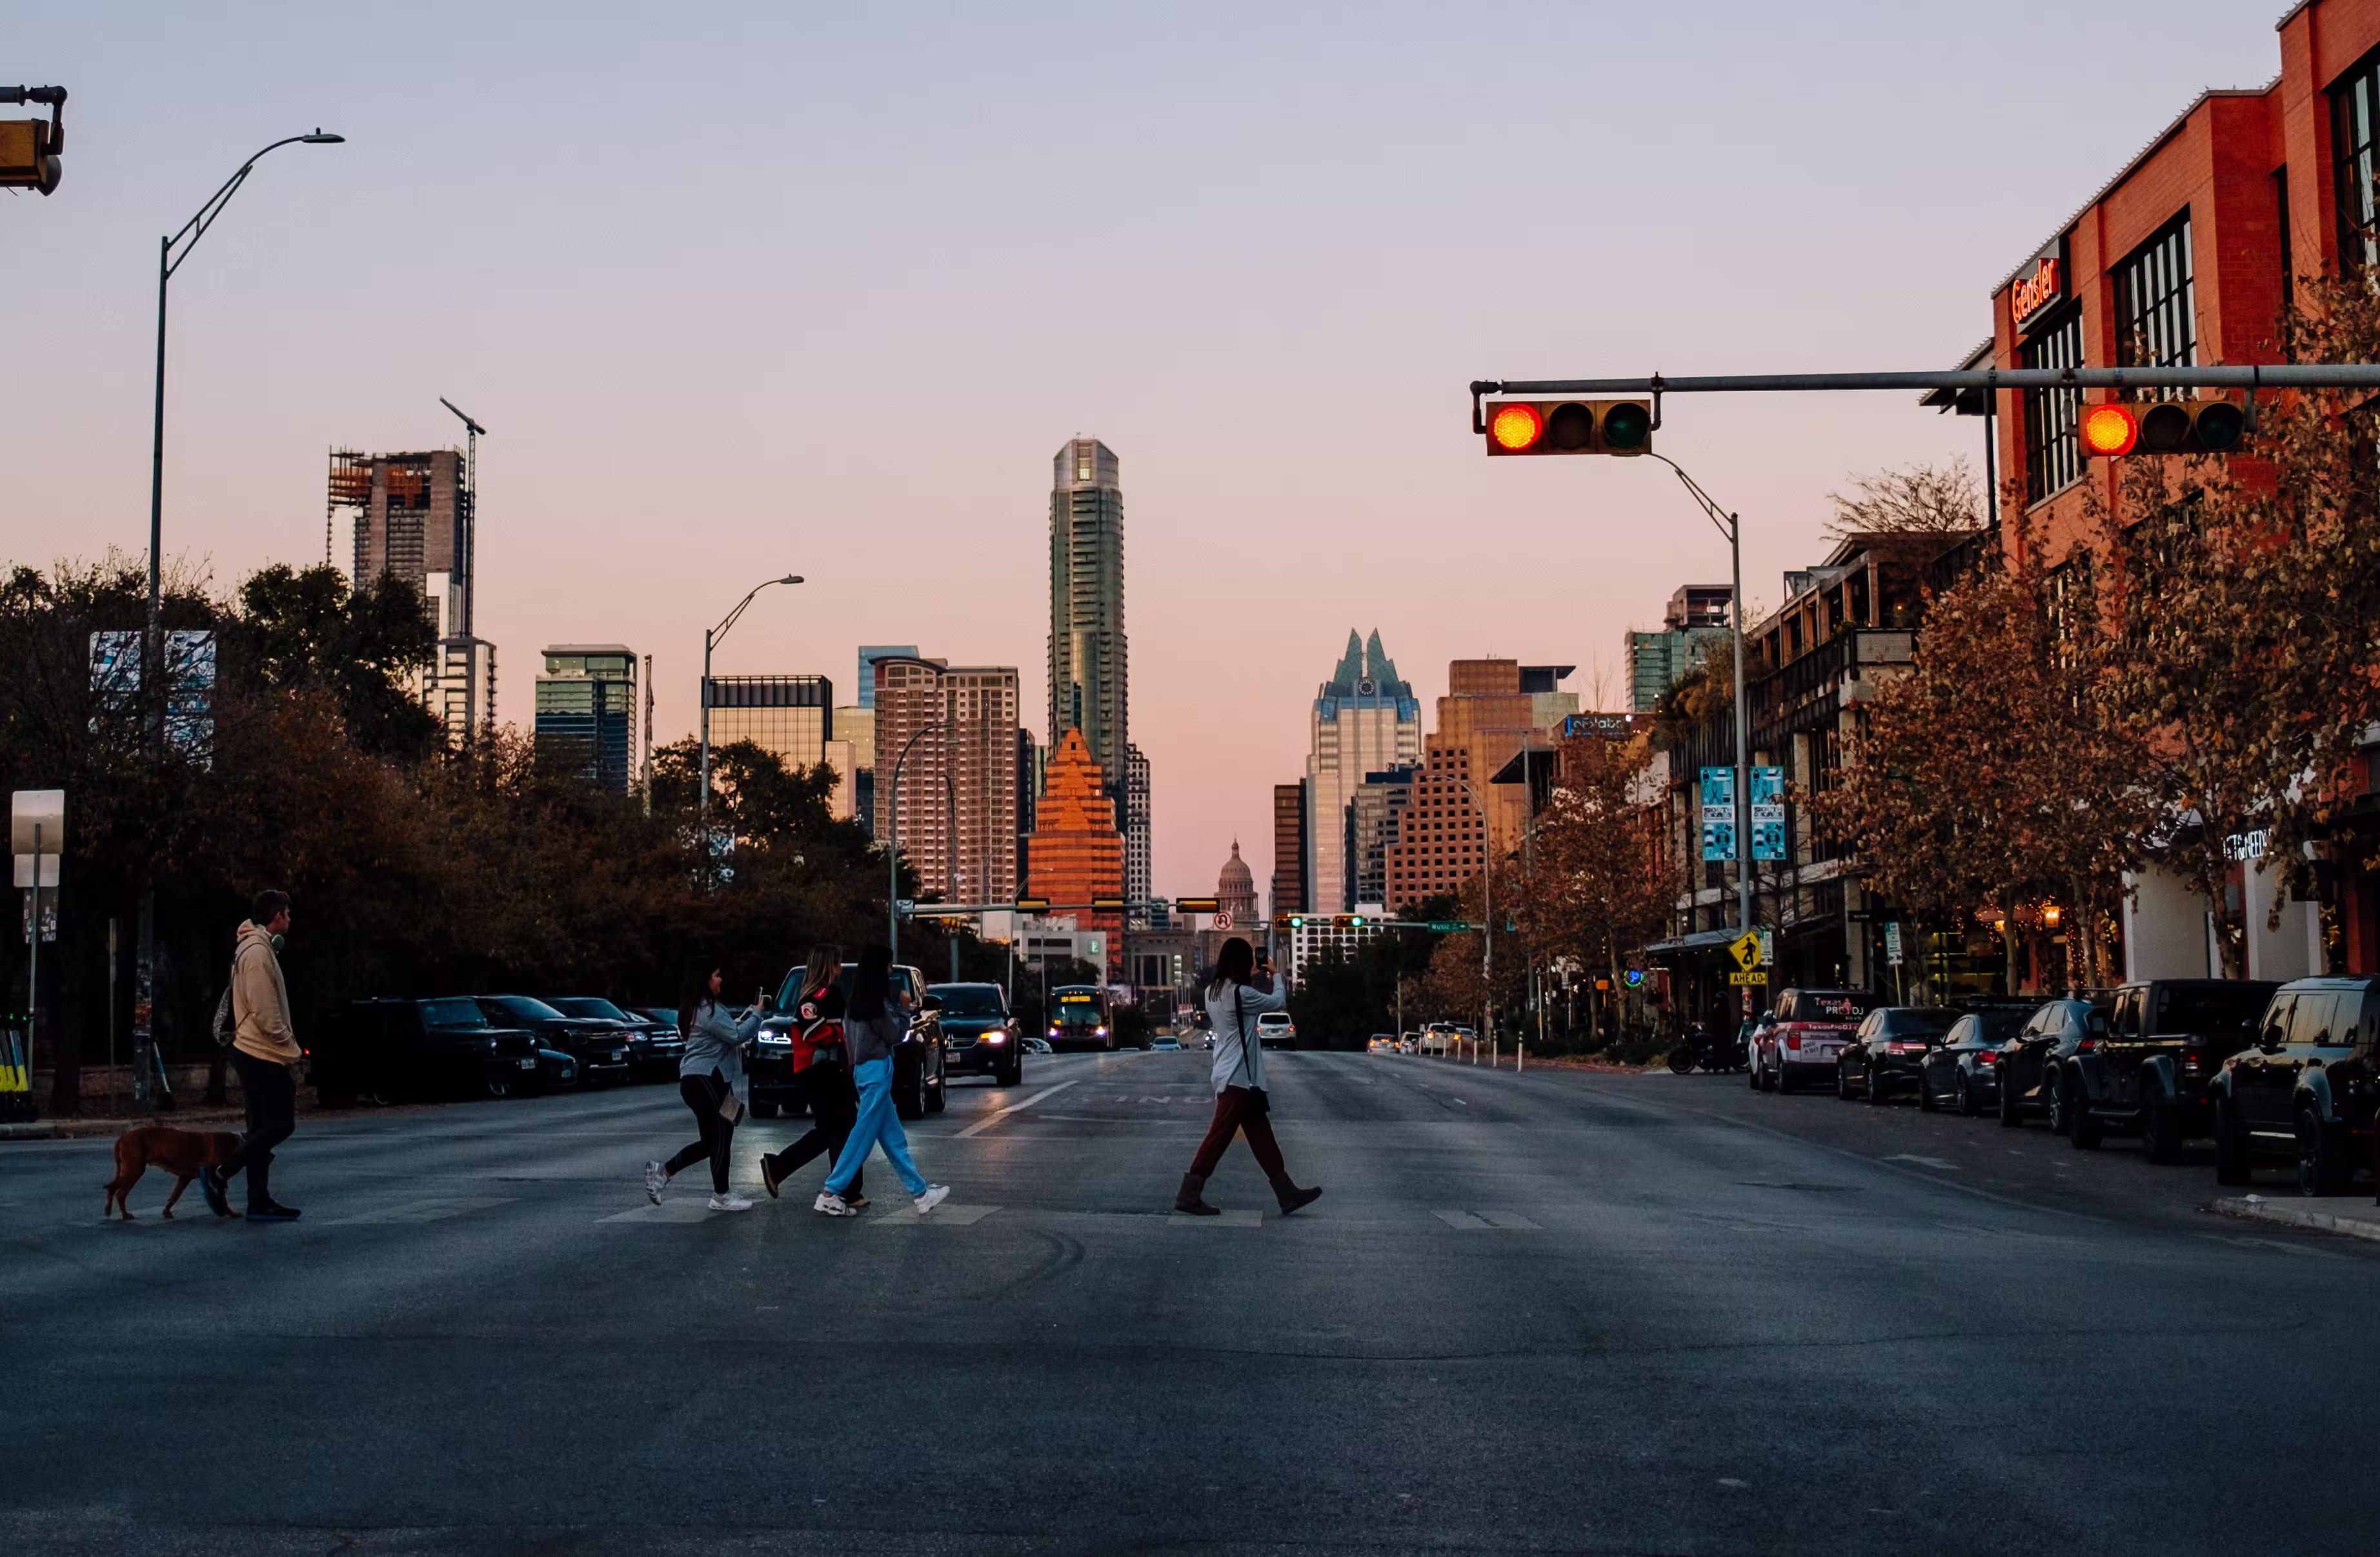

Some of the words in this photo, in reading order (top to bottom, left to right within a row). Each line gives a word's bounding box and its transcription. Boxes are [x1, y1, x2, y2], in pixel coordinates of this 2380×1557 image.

[2012, 258, 2054, 324] Gensler
[1733, 973, 1764, 983] AHEAD
[1815, 997, 1842, 1006] Texas
[1852, 1006, 1864, 1015] DJ
